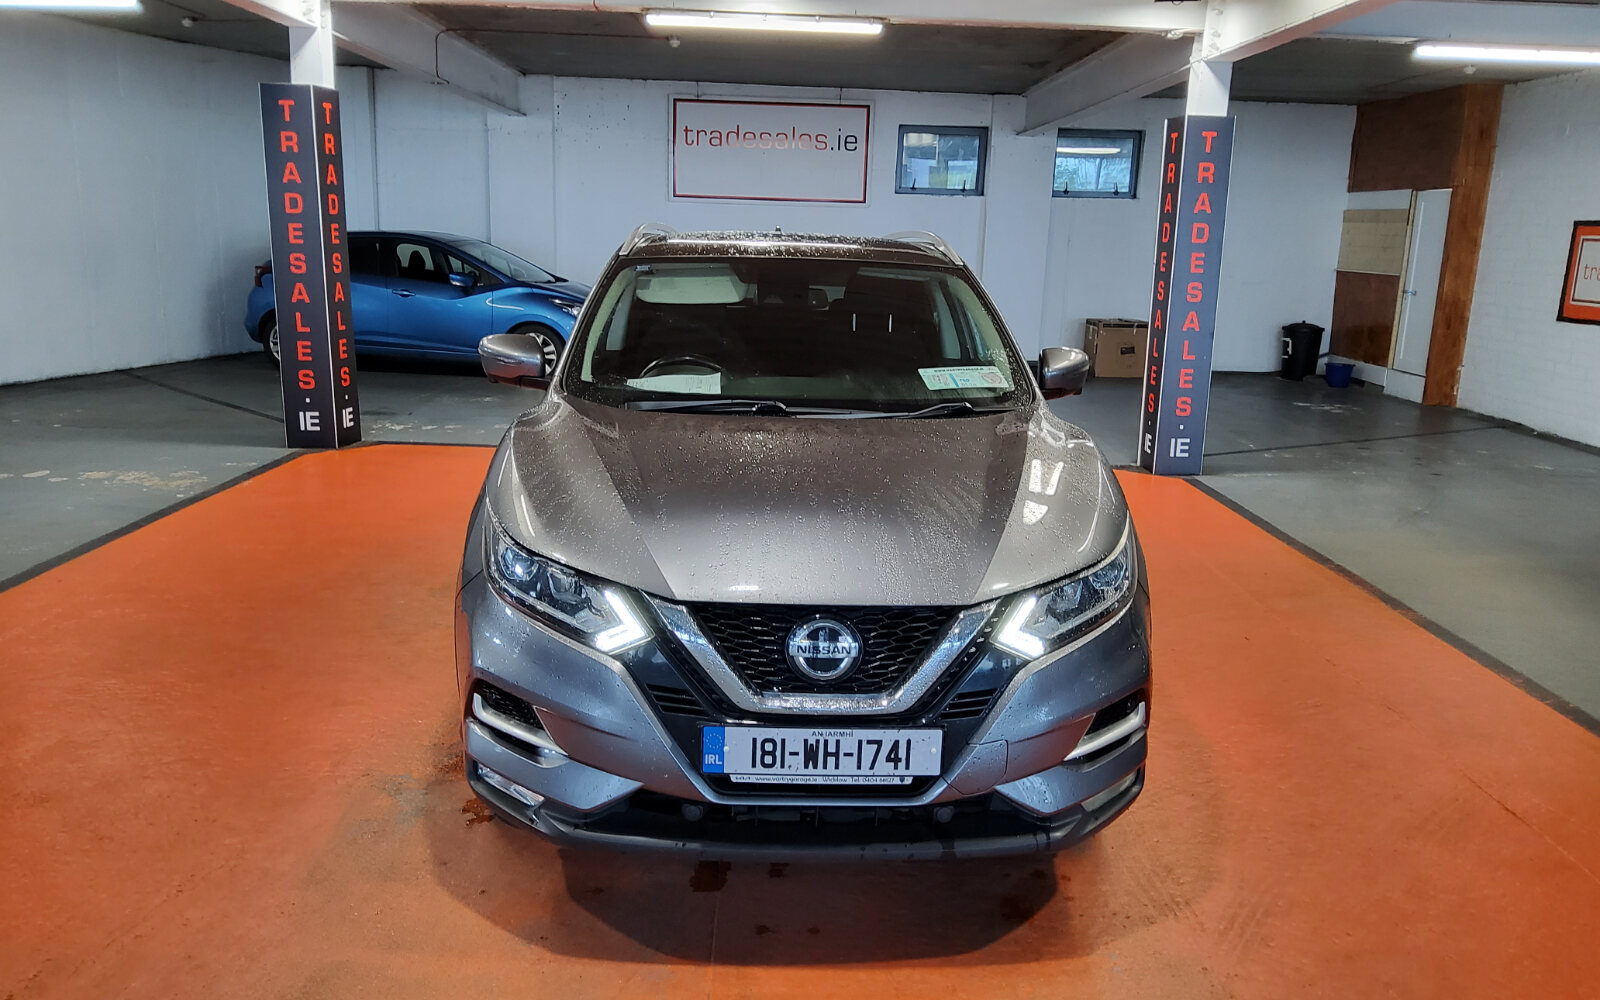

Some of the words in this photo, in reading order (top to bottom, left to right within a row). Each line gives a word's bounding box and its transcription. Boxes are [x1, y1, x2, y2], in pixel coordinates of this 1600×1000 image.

[683, 124, 858, 152] tradesales.ie
[796, 645, 852, 655] NISSAN
[704, 754, 723, 765] IRL
[751, 737, 912, 770] 181-WH-1741
